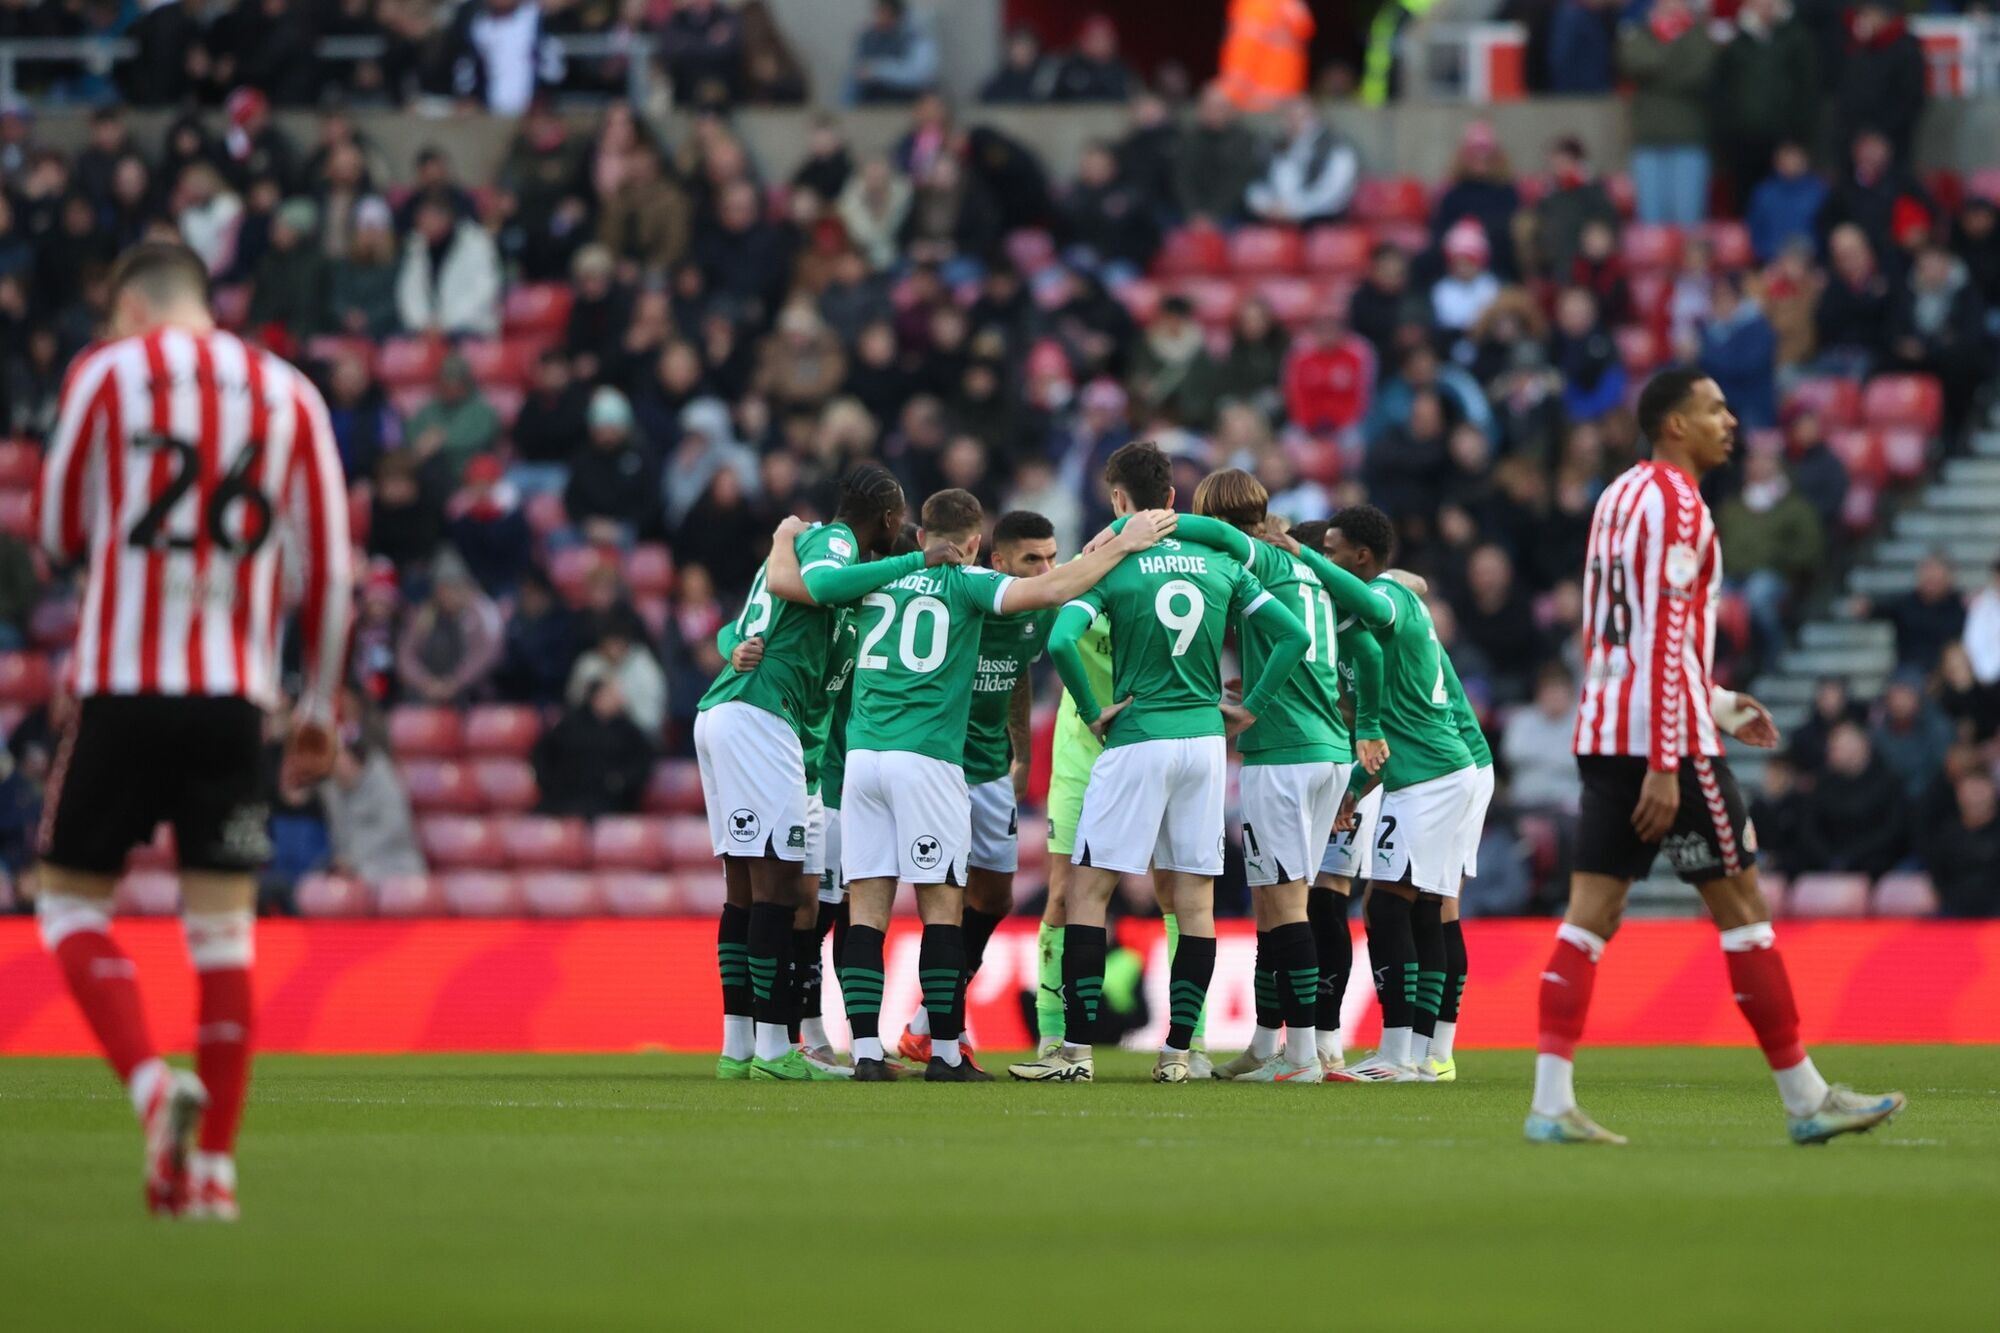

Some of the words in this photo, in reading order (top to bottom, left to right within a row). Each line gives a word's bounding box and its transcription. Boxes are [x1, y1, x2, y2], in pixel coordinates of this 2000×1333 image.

[129, 431, 274, 557] 26
[1138, 555, 1208, 574] HARDIE
[882, 574, 942, 595] ANDELL
[1155, 579, 1205, 657] 9
[1298, 582, 1336, 669] 11
[857, 592, 950, 673] 20
[977, 655, 1018, 673] lassic
[973, 674, 1017, 692] uilders
[1378, 815, 1397, 849] 2
[916, 855, 937, 863] retain
